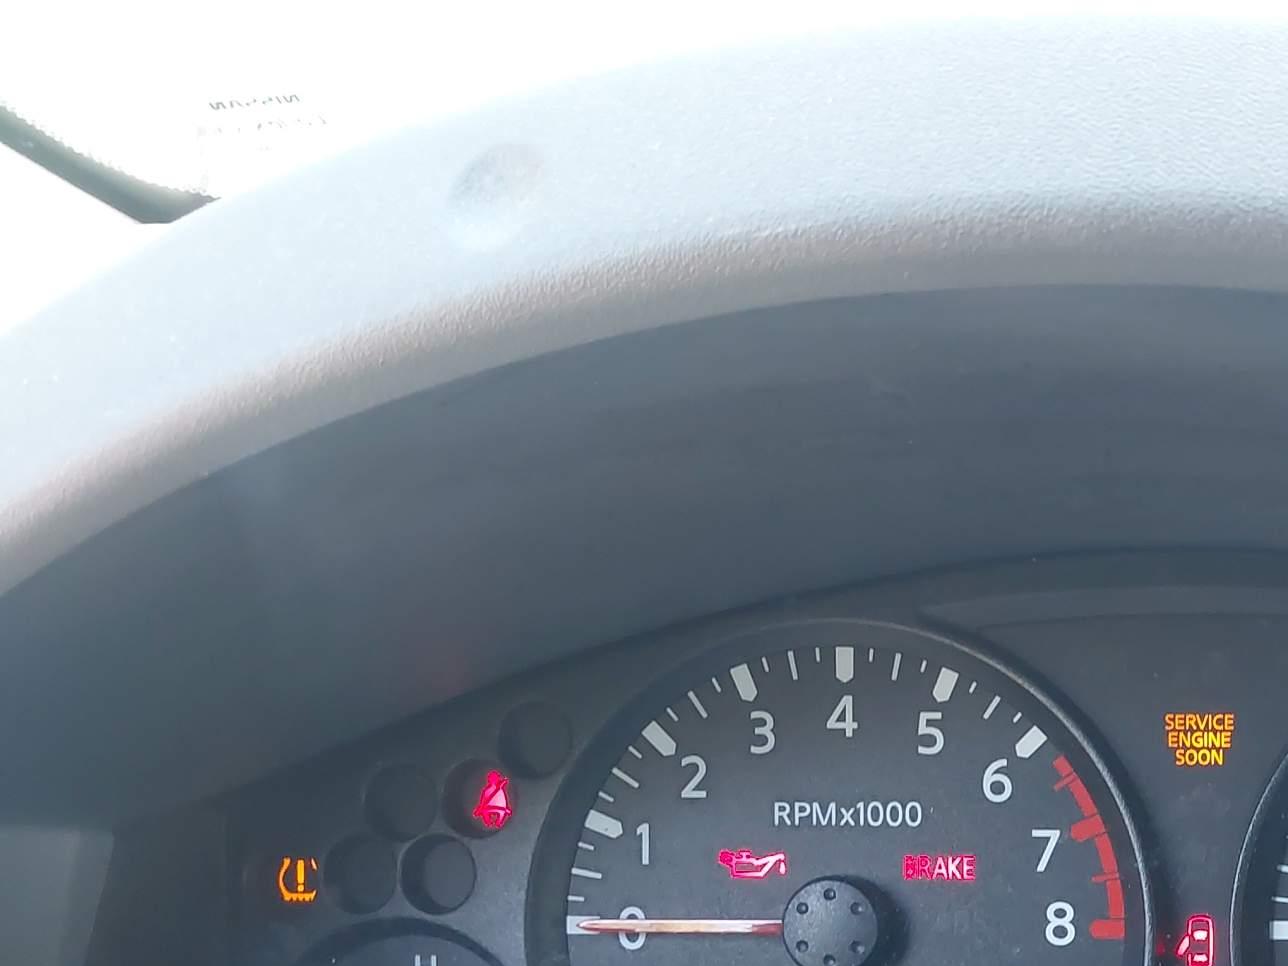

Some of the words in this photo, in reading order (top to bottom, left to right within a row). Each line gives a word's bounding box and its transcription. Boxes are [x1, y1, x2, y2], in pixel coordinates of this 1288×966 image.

[749, 711, 775, 755] 3
[827, 695, 858, 737] 4
[917, 712, 944, 755] 5
[1164, 713, 1234, 730] SERVICE
[1168, 731, 1231, 748] ENGINE
[1175, 749, 1223, 765] SOON
[680, 755, 708, 799] 2
[982, 758, 1012, 803] 6
[637, 823, 650, 865] 1
[1031, 829, 1061, 873] 7
[903, 855, 977, 881] BRAKE
[617, 906, 647, 951] 0
[1045, 902, 1075, 946] 8
